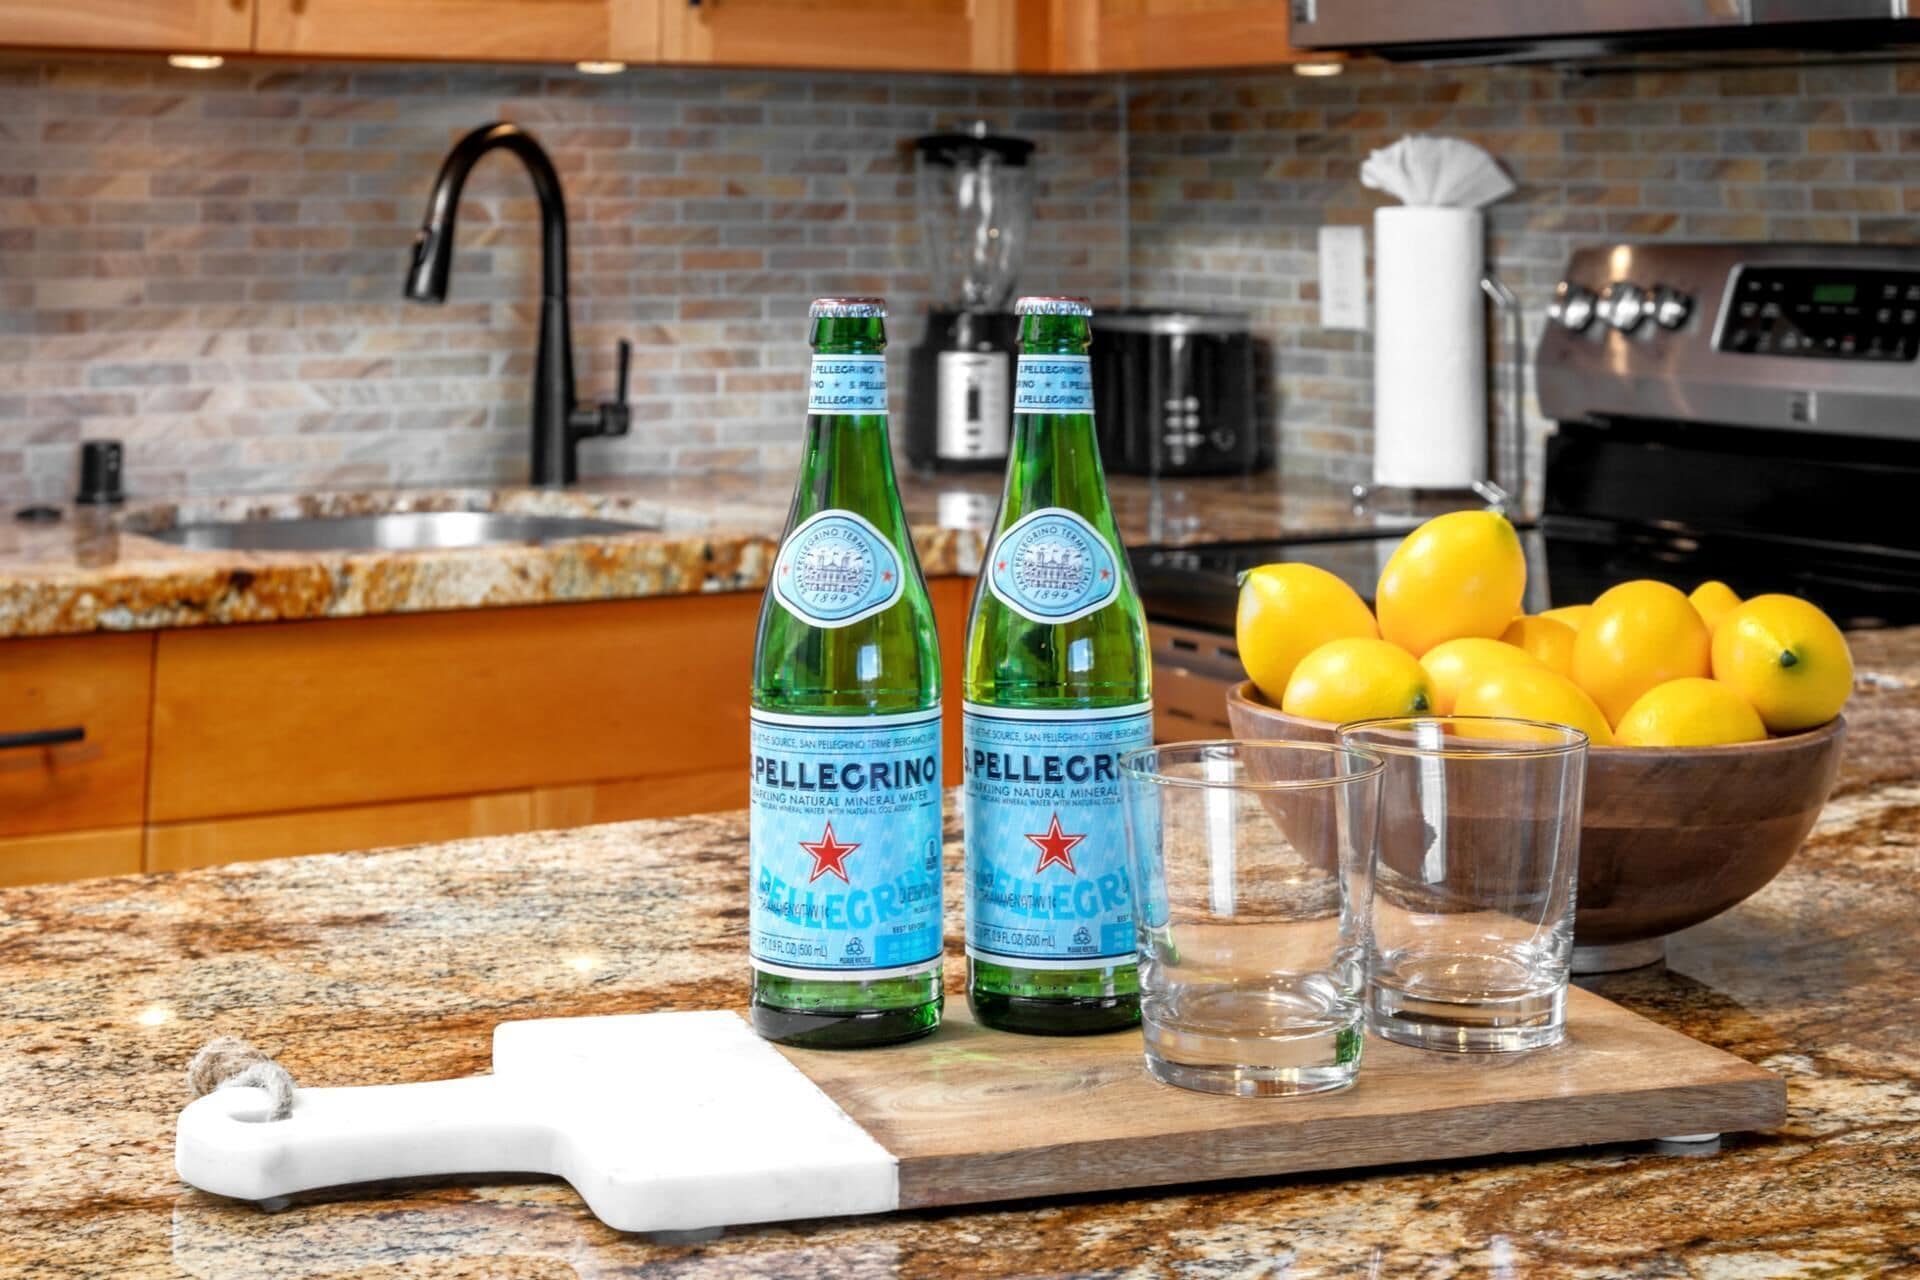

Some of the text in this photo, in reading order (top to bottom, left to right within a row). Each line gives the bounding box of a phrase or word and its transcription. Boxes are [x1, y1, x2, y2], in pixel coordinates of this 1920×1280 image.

[843, 529, 869, 554] TERME
[1015, 526, 1058, 568] PELLEGRINO
[812, 593, 848, 604] 1899
[1033, 590, 1069, 600] 1899
[789, 795, 840, 807] NATURAL
[845, 795, 896, 807] MINERAL
[899, 789, 929, 802] WATER
[1014, 787, 1065, 800] NATURAL
[1070, 785, 1119, 798] MINERAL
